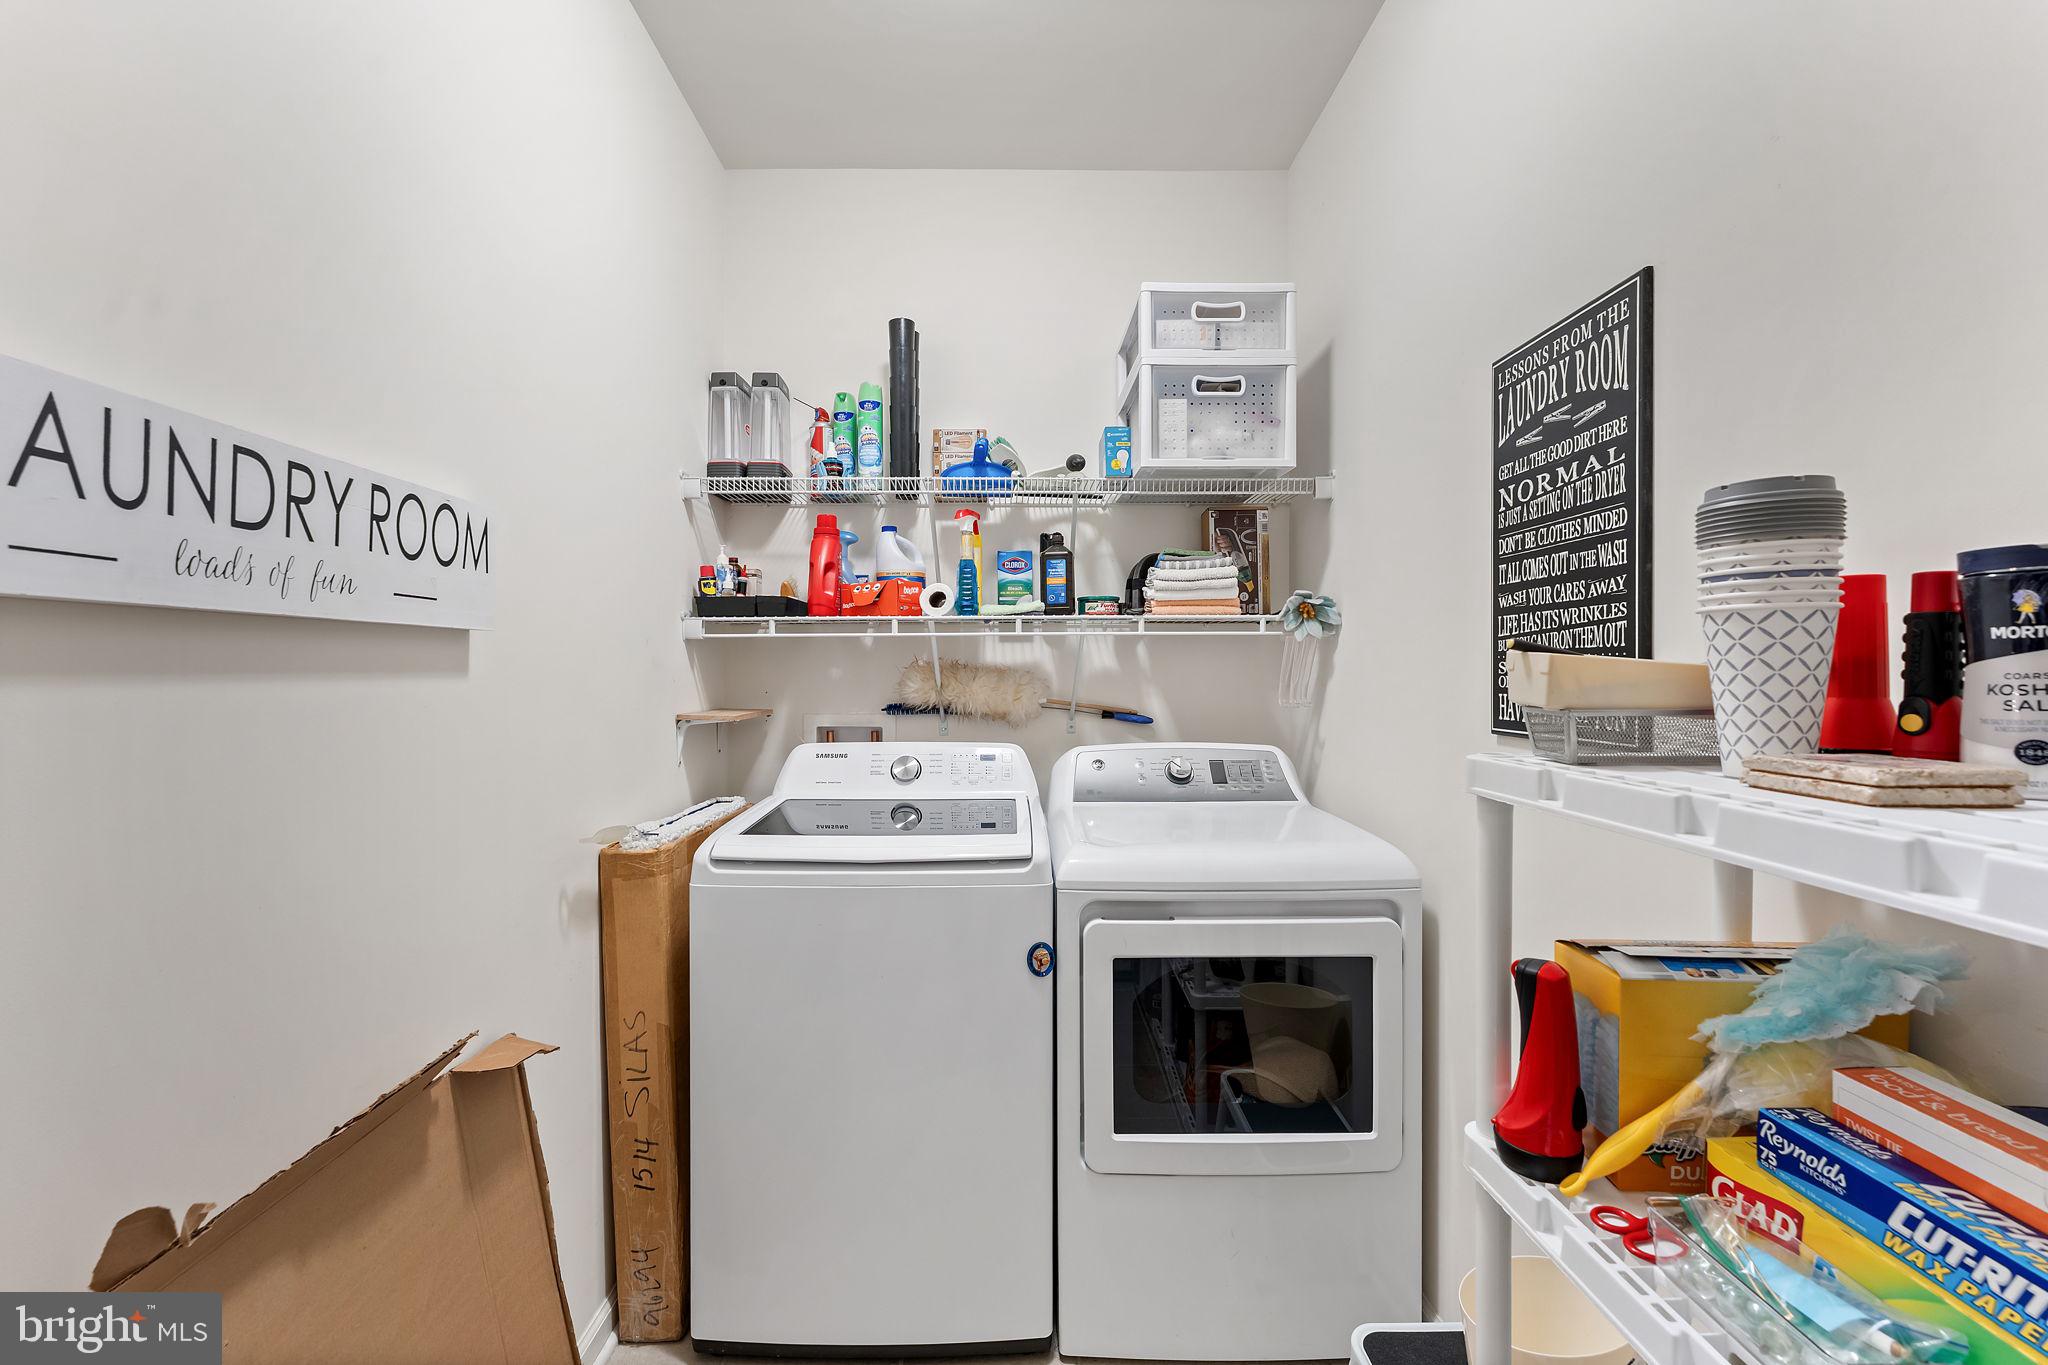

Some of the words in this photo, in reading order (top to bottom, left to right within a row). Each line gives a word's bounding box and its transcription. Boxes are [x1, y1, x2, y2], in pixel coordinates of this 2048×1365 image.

[1498, 345, 1549, 391] LESSONS
[1552, 319, 1593, 359] FROM
[1596, 297, 1630, 333] THE
[1498, 356, 1570, 448] LAUNDRY
[1575, 324, 1629, 394] ROOM
[1499, 461, 1513, 481] GET
[1514, 456, 1530, 476] ALL
[1530, 450, 1547, 469] THE
[1547, 438, 1574, 462] GOOD
[1574, 428, 1599, 452] DIRT
[1598, 415, 1628, 442] HERE
[1498, 446, 1626, 513] NORMAL
[1498, 513, 1505, 528] IS
[1505, 505, 1522, 526] JUST
[1522, 502, 1529, 521] A
[1529, 489, 1560, 520] SETTING
[1562, 483, 1575, 510] ON
[1575, 475, 1593, 506] THE
[1595, 462, 1627, 501] DRYER
[368, 483, 490, 575] ROOM
[1498, 533, 1523, 554] DON'T
[1525, 530, 1537, 548] BE
[1537, 518, 1581, 546] CLOTHES
[1583, 507, 1628, 535] MINDED
[174, 538, 255, 587] loads
[268, 555, 294, 601] of
[309, 558, 359, 602] fun
[1004, 561, 1025, 569] CLOROX
[1498, 564, 1508, 585] IT
[1507, 561, 1522, 584] ALL
[1521, 556, 1549, 581] COMES
[1550, 551, 1569, 577] OUT
[1569, 553, 1579, 571] IN
[1579, 550, 1597, 568] THE
[1597, 538, 1628, 567] WASH
[1498, 590, 1527, 609] WASH
[1528, 585, 1553, 606] YOUR
[1553, 580, 1586, 603] CARES
[1587, 574, 1628, 599] AWAY
[1498, 614, 1520, 637] LIFE
[1520, 611, 1541, 632] HAS
[1541, 608, 1559, 629] ITS
[1560, 601, 1628, 625] WRINKLES
[1550, 629, 1574, 649] IRON
[1574, 623, 1604, 648] THEM
[1604, 620, 1628, 648] OUT
[1498, 693, 1525, 722] HAV
[1844, 1116, 1882, 1143] TWIST
[1884, 1137, 1905, 1155] TIE
[1862, 1074, 1926, 1098] food
[1919, 1100, 1948, 1111] &
[1946, 1113, 2039, 1150] bread
[631, 1137, 660, 1191] 1514
[1670, 1165, 1703, 1180] DU
[1759, 1145, 1778, 1167] 75
[1760, 1118, 1847, 1187] Reynolds
[1799, 1162, 1847, 1196] KITCHENS
[1711, 1175, 1799, 1243] GLAD
[1881, 1230, 1952, 1283] WAX
